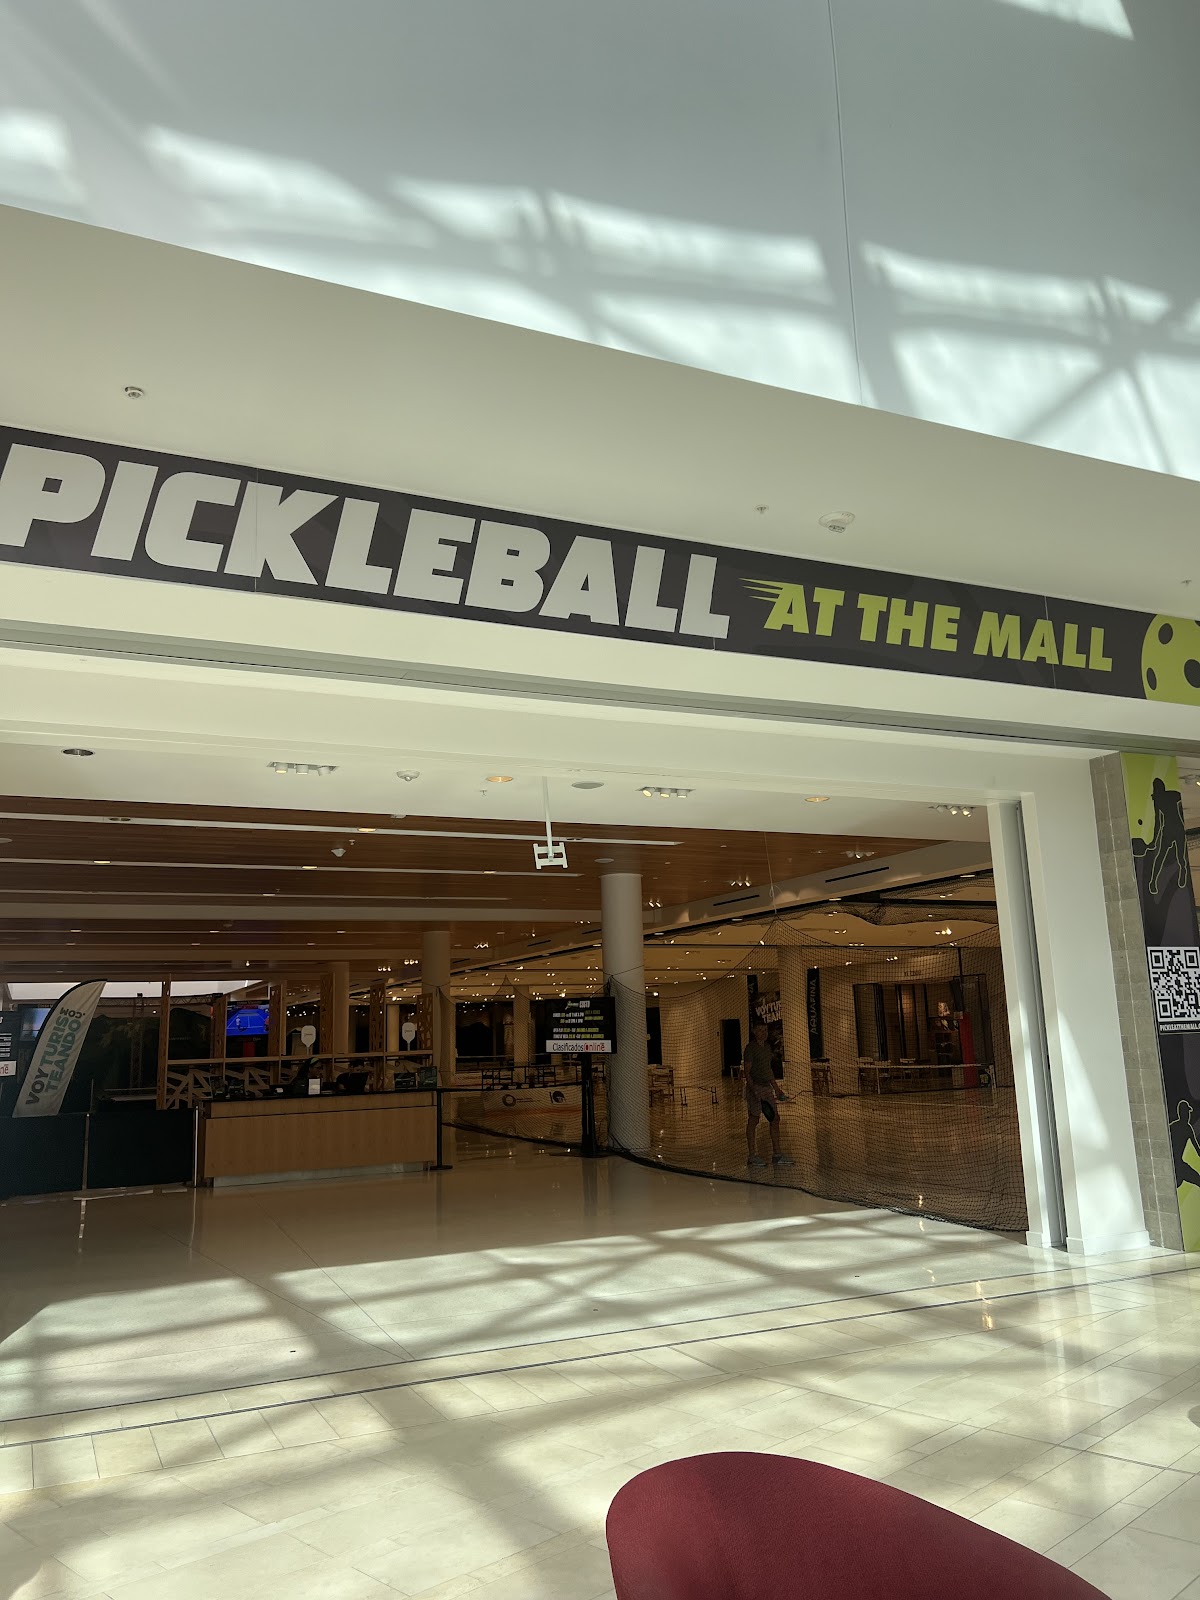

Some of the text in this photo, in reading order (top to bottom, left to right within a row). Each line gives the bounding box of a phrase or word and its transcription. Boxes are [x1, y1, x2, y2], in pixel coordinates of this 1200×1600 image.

[0, 443, 1113, 672] PICKLEBALL AT THE MALL
[809, 979, 819, 1035] AQUAFINA
[44, 1019, 82, 1093] TEANDO
